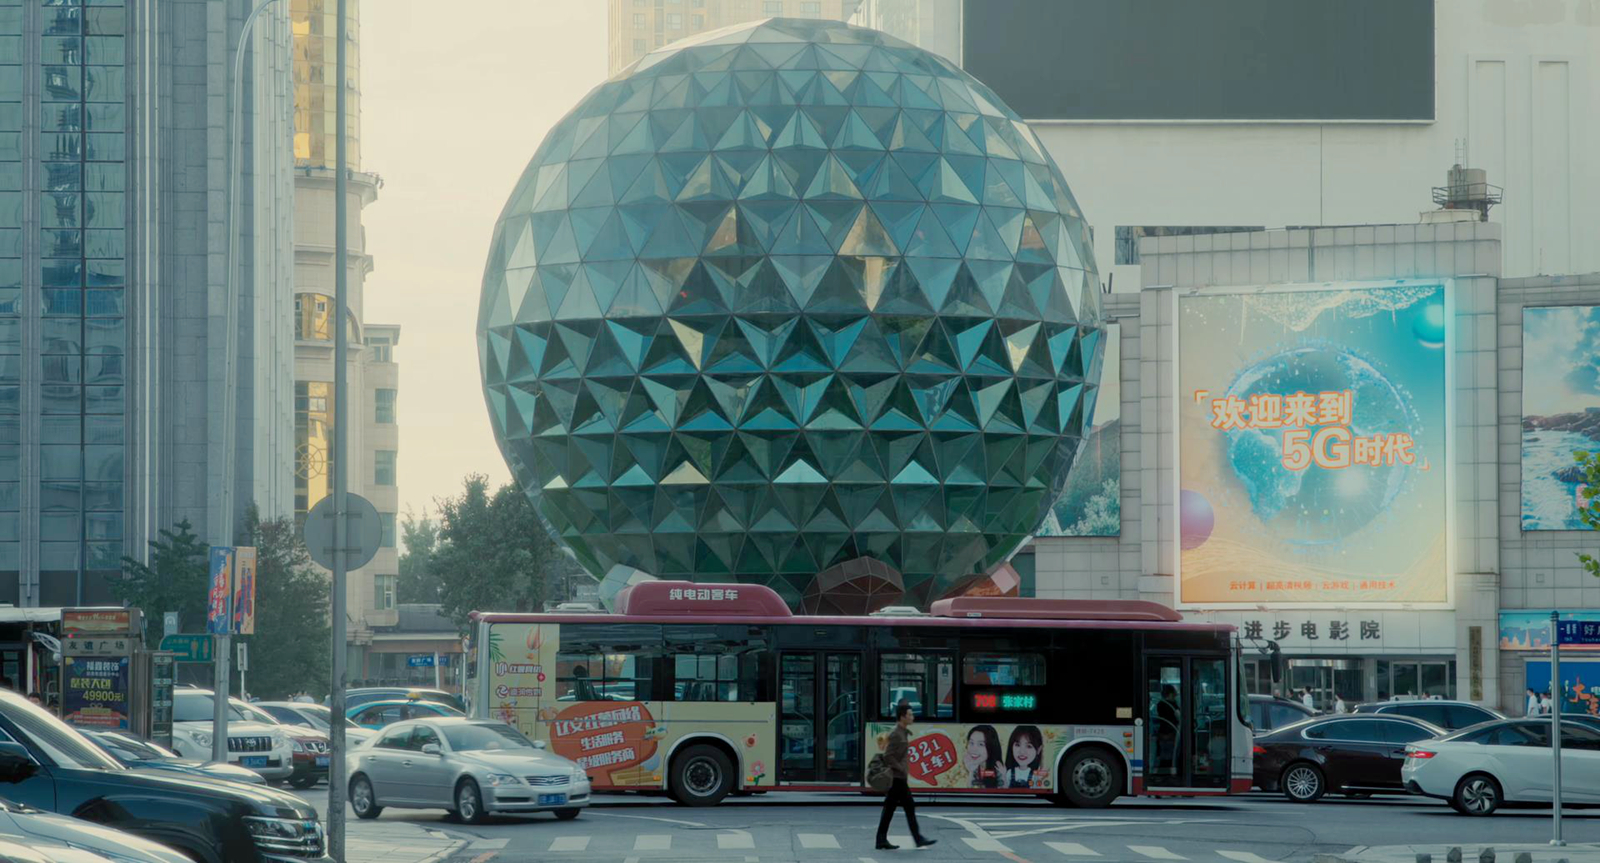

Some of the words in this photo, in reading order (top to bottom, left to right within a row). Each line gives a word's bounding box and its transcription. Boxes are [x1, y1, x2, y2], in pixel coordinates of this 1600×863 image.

[669, 588, 739, 600] 纯电动客车
[1244, 620, 1381, 640] 进步电影院
[69, 641, 125, 650] 友谊广场
[581, 730, 624, 751] 生活服务
